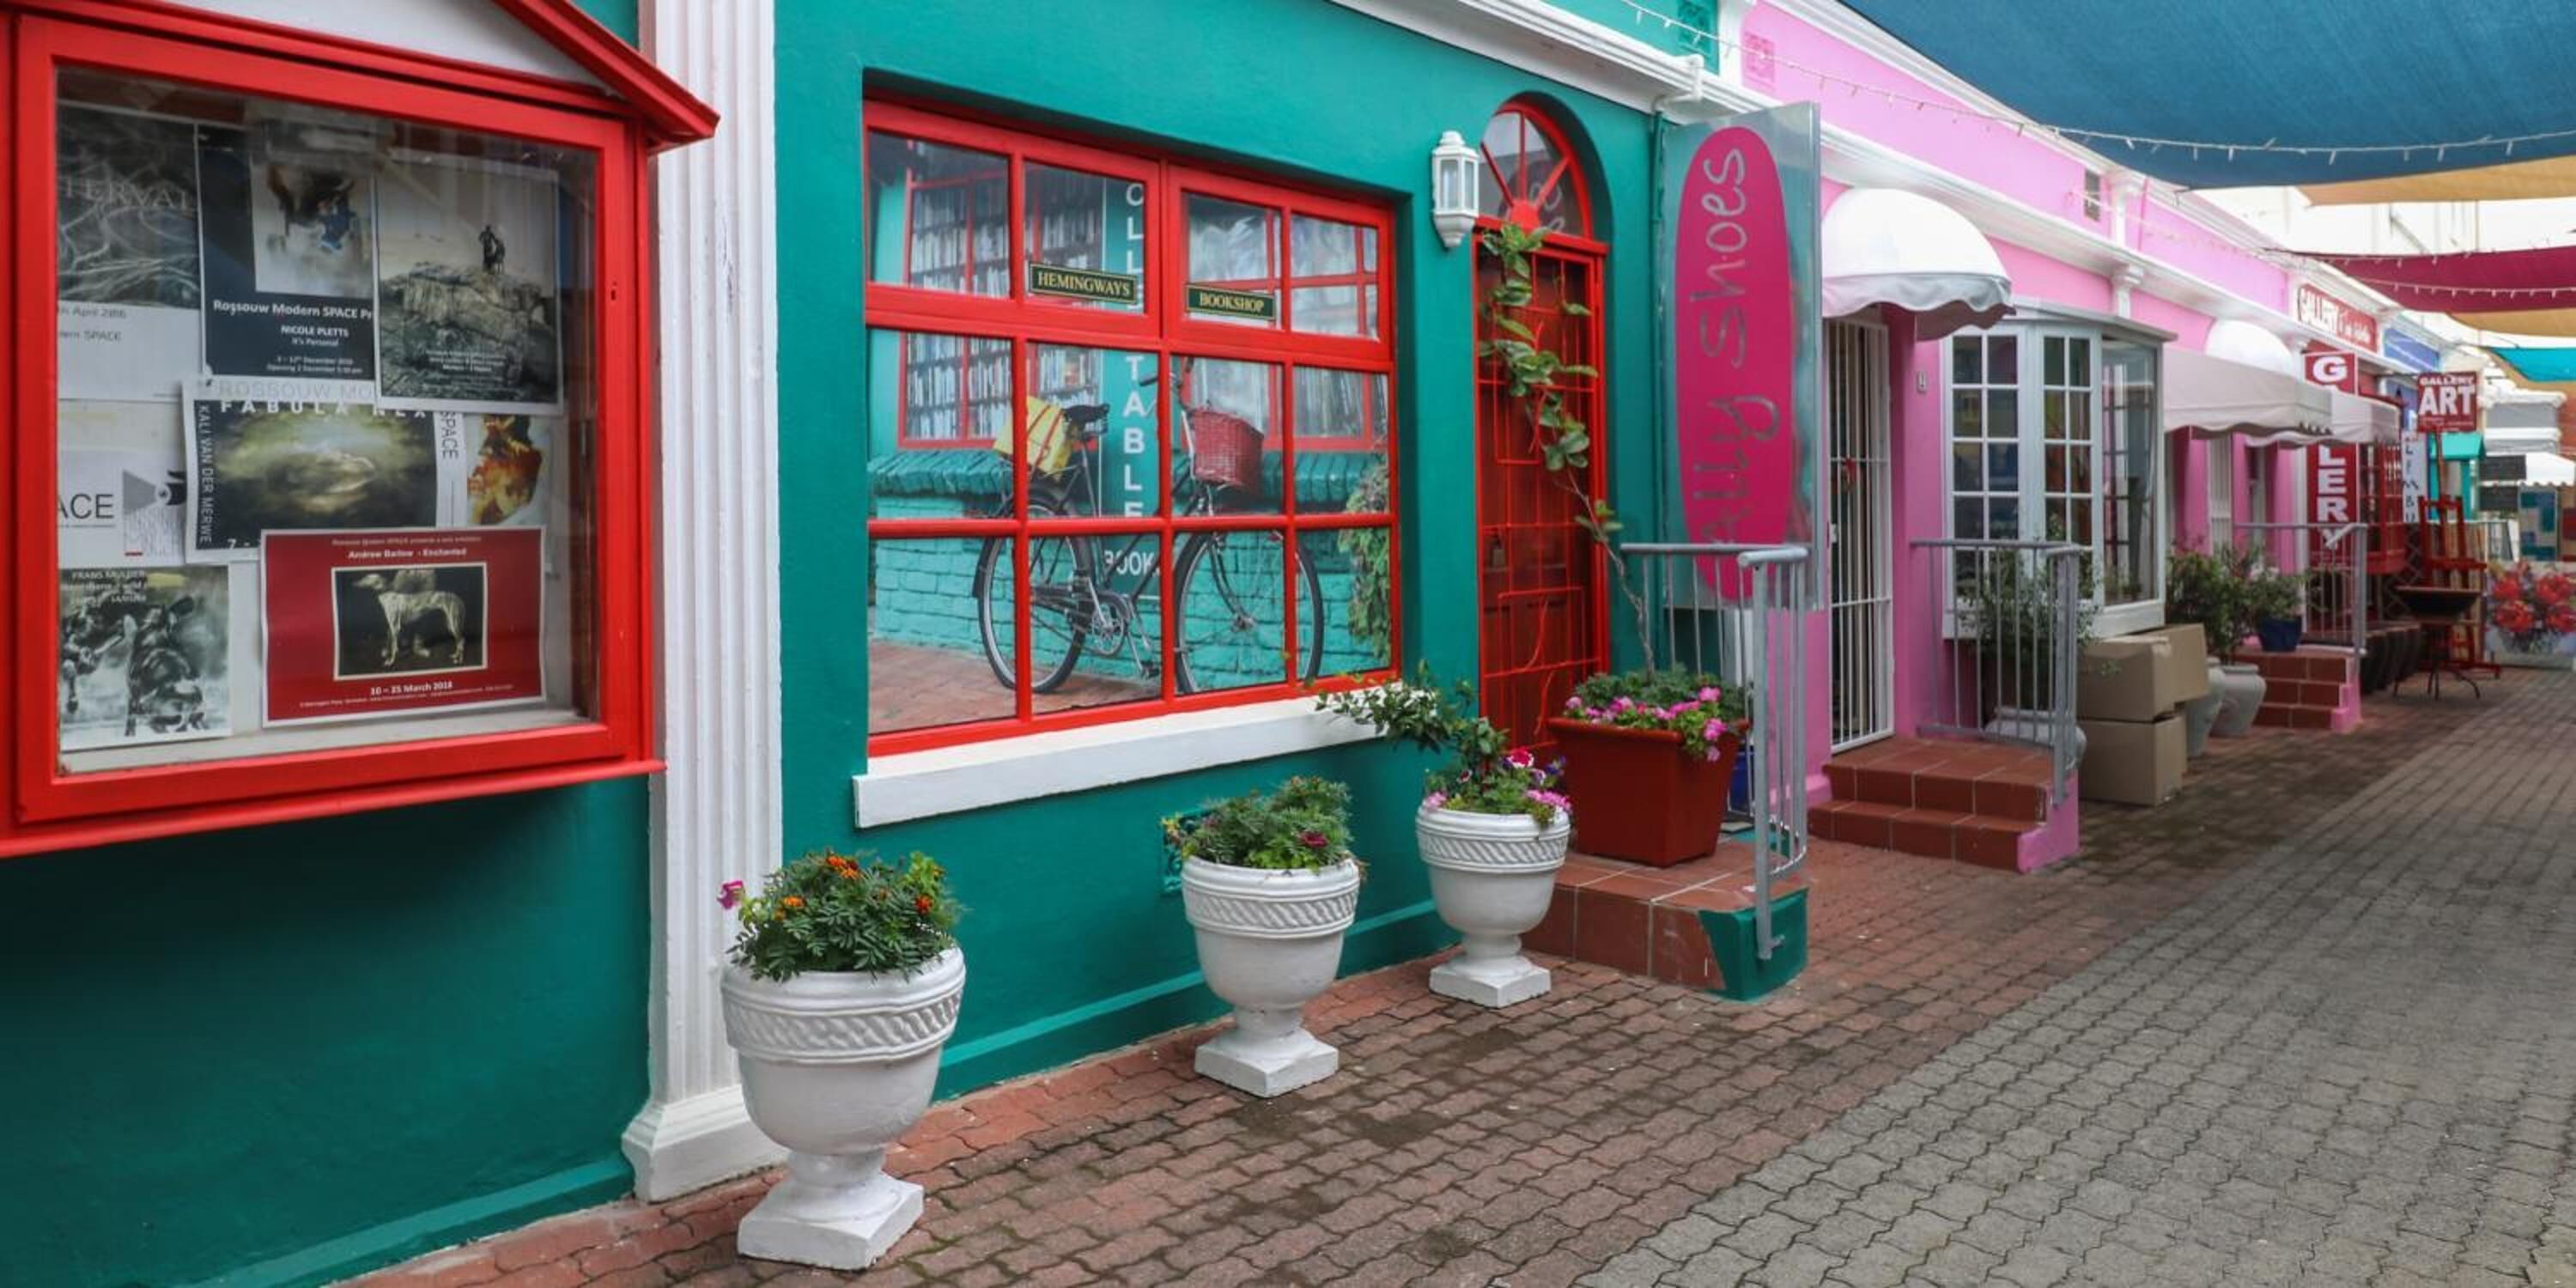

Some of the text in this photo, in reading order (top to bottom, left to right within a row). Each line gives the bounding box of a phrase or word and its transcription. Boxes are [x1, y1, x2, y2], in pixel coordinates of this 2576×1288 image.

[1037, 270, 1131, 297] HEMINGWAYS
[213, 301, 269, 315] Rossouw
[272, 304, 321, 318] Modern
[324, 307, 360, 319] SPACE
[1199, 293, 1265, 313] BOOKSHOP
[281, 325, 349, 337] NICOLE PLETTS
[221, 381, 331, 399] ROSSOUW
[221, 400, 349, 413] FABULA
[2419, 386, 2475, 415] ART
[440, 410, 459, 460] SPACE
[2312, 355, 2349, 551] GLERY
[198, 404, 214, 544] KALI VAN DER MERWE
[348, 550, 382, 559] Andrew
[1104, 549, 1159, 576] BOOK
[403, 683, 431, 694] March
